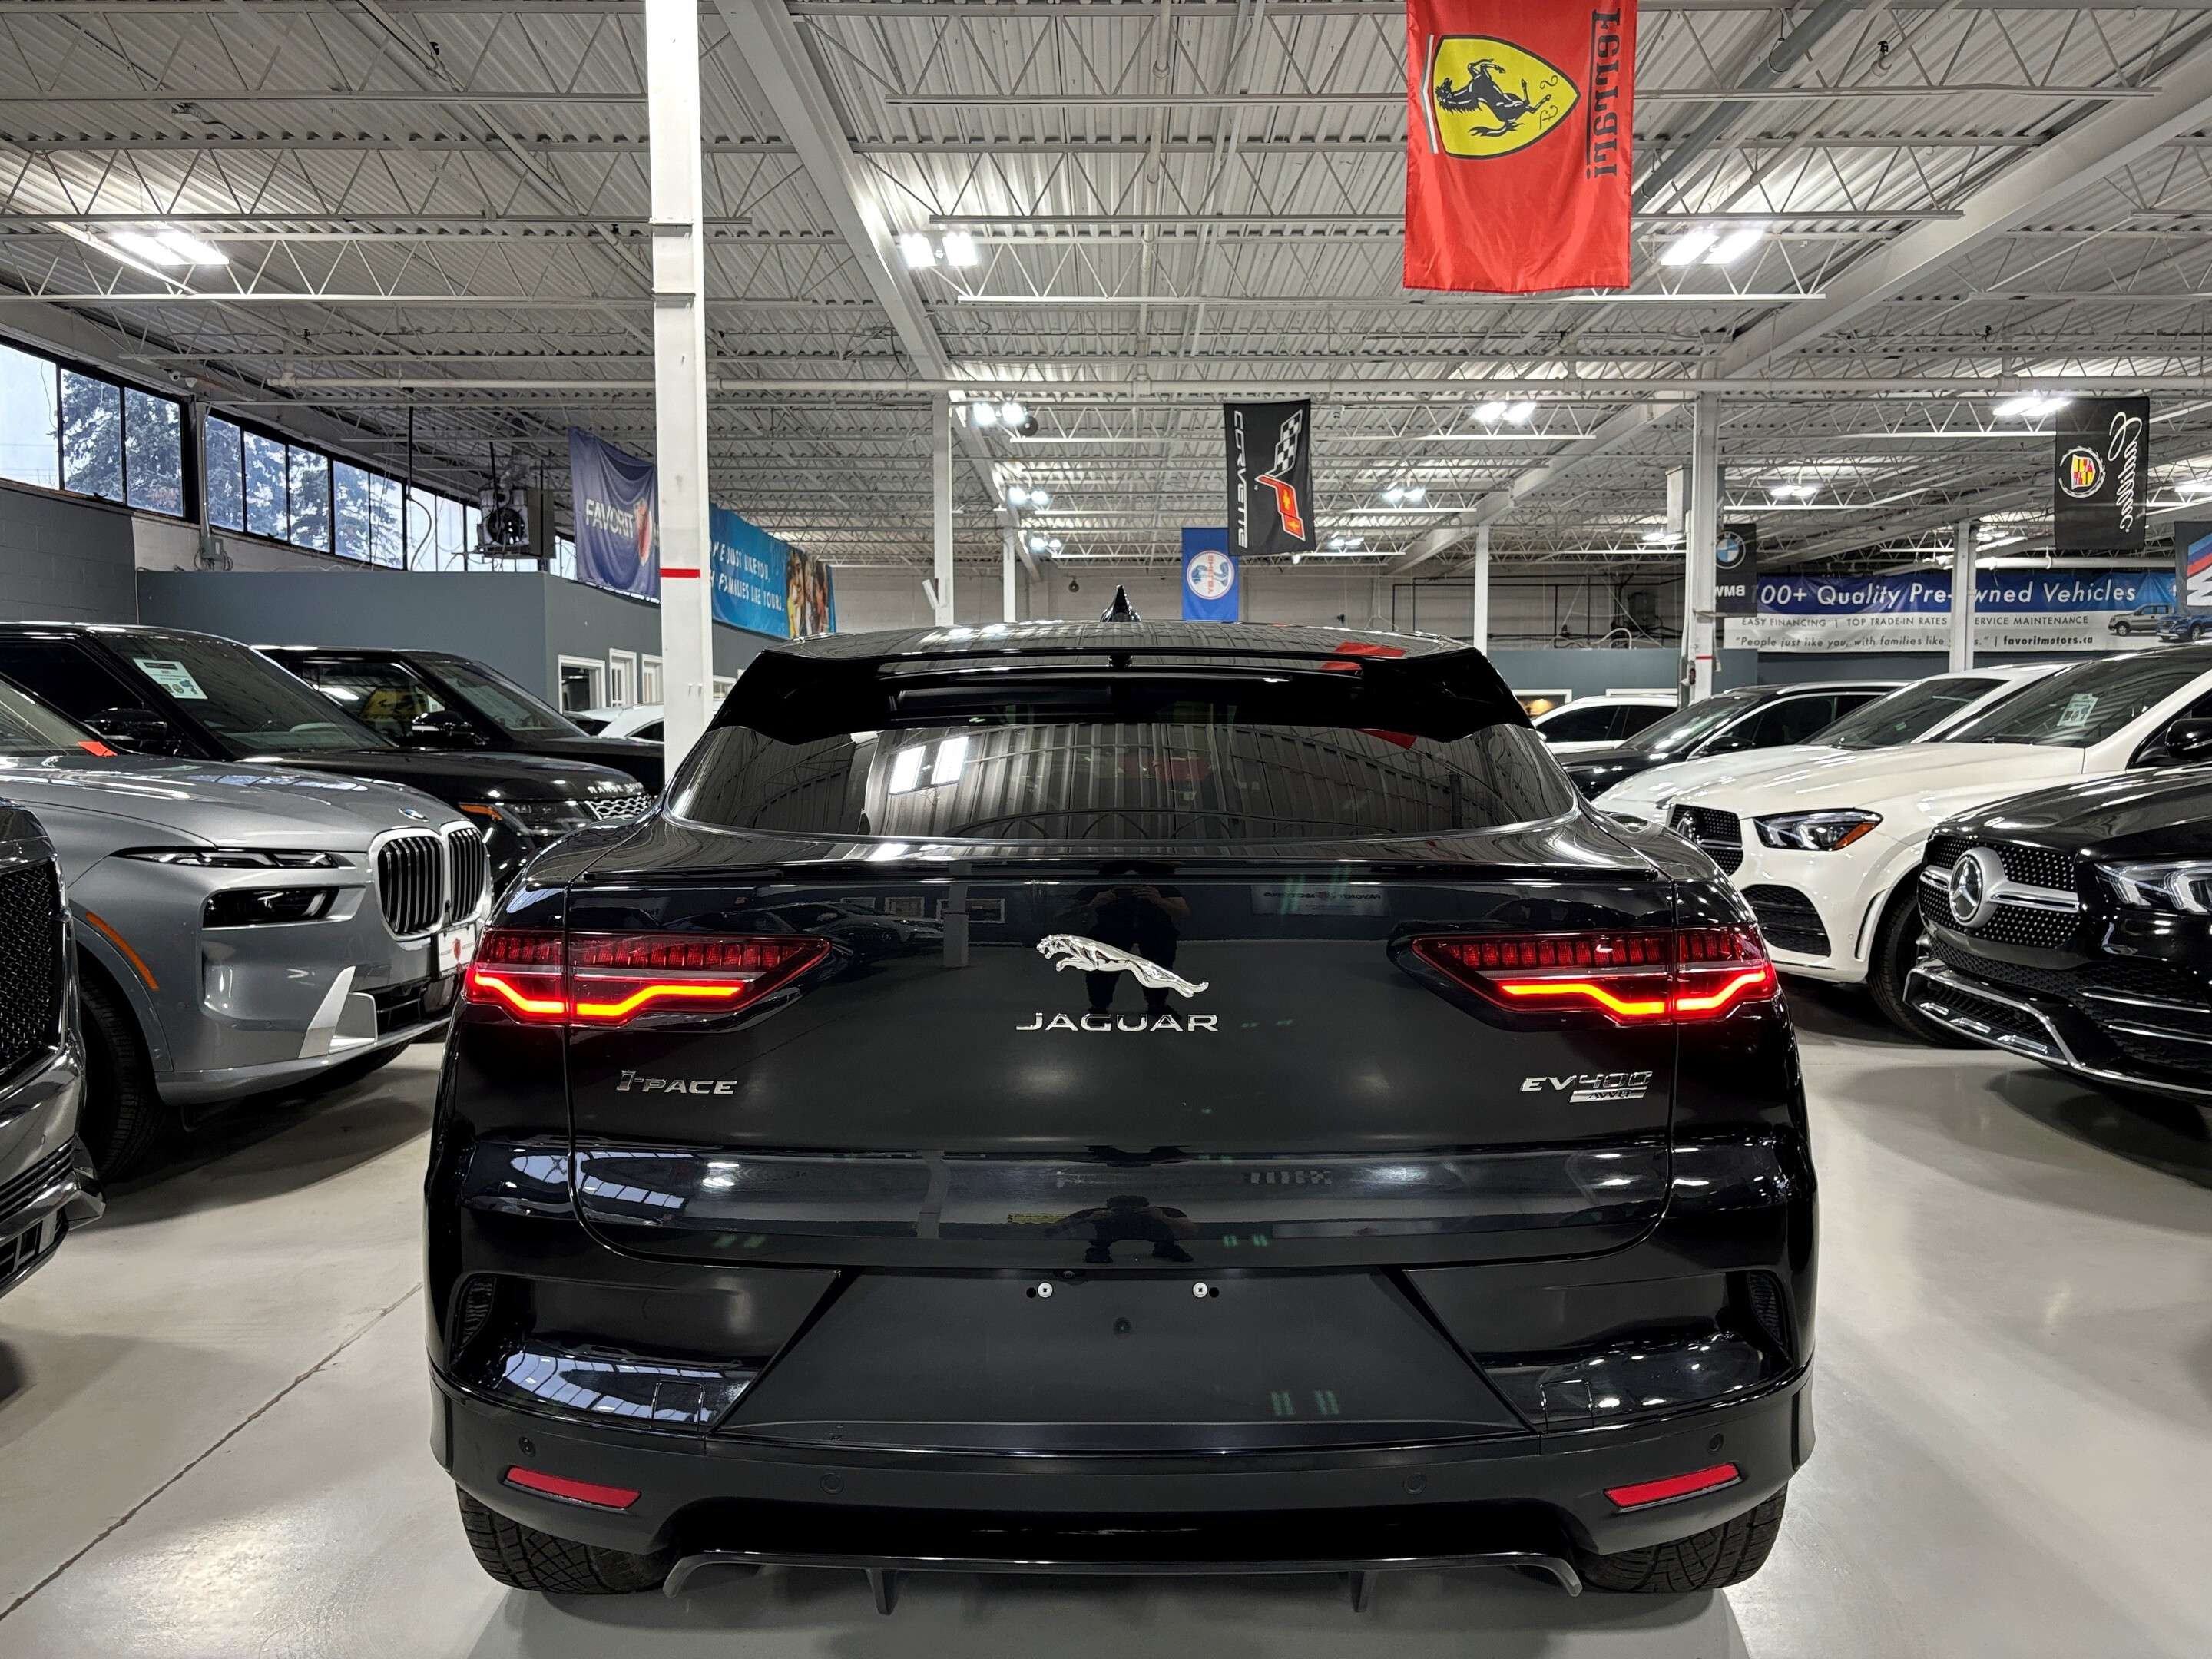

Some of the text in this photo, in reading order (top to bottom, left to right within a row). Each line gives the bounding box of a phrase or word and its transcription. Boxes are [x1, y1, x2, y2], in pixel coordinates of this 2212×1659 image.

[1233, 410, 1248, 549] CORVETTE
[585, 498, 634, 538] FAVORIT
[719, 573, 750, 601] FAMILIES
[1817, 582, 1901, 609] Quality
[2043, 578, 2137, 603] Vehicles
[1742, 615, 2089, 628] EASY FINANCING TOP TRADE-IN RATES ERVICE MAINTENANCE
[1780, 637, 1801, 648] just
[1804, 636, 1824, 647] like
[1826, 638, 1849, 649] you,
[1854, 636, 1876, 647] with
[1880, 635, 1922, 647] families
[1926, 635, 1945, 646] like
[2003, 635, 2093, 646] favoritmotors.ca
[1016, 1012, 1218, 1031] JAGUAR
[616, 1069, 737, 1094] I-PACE
[1521, 1071, 1653, 1092] EV400
